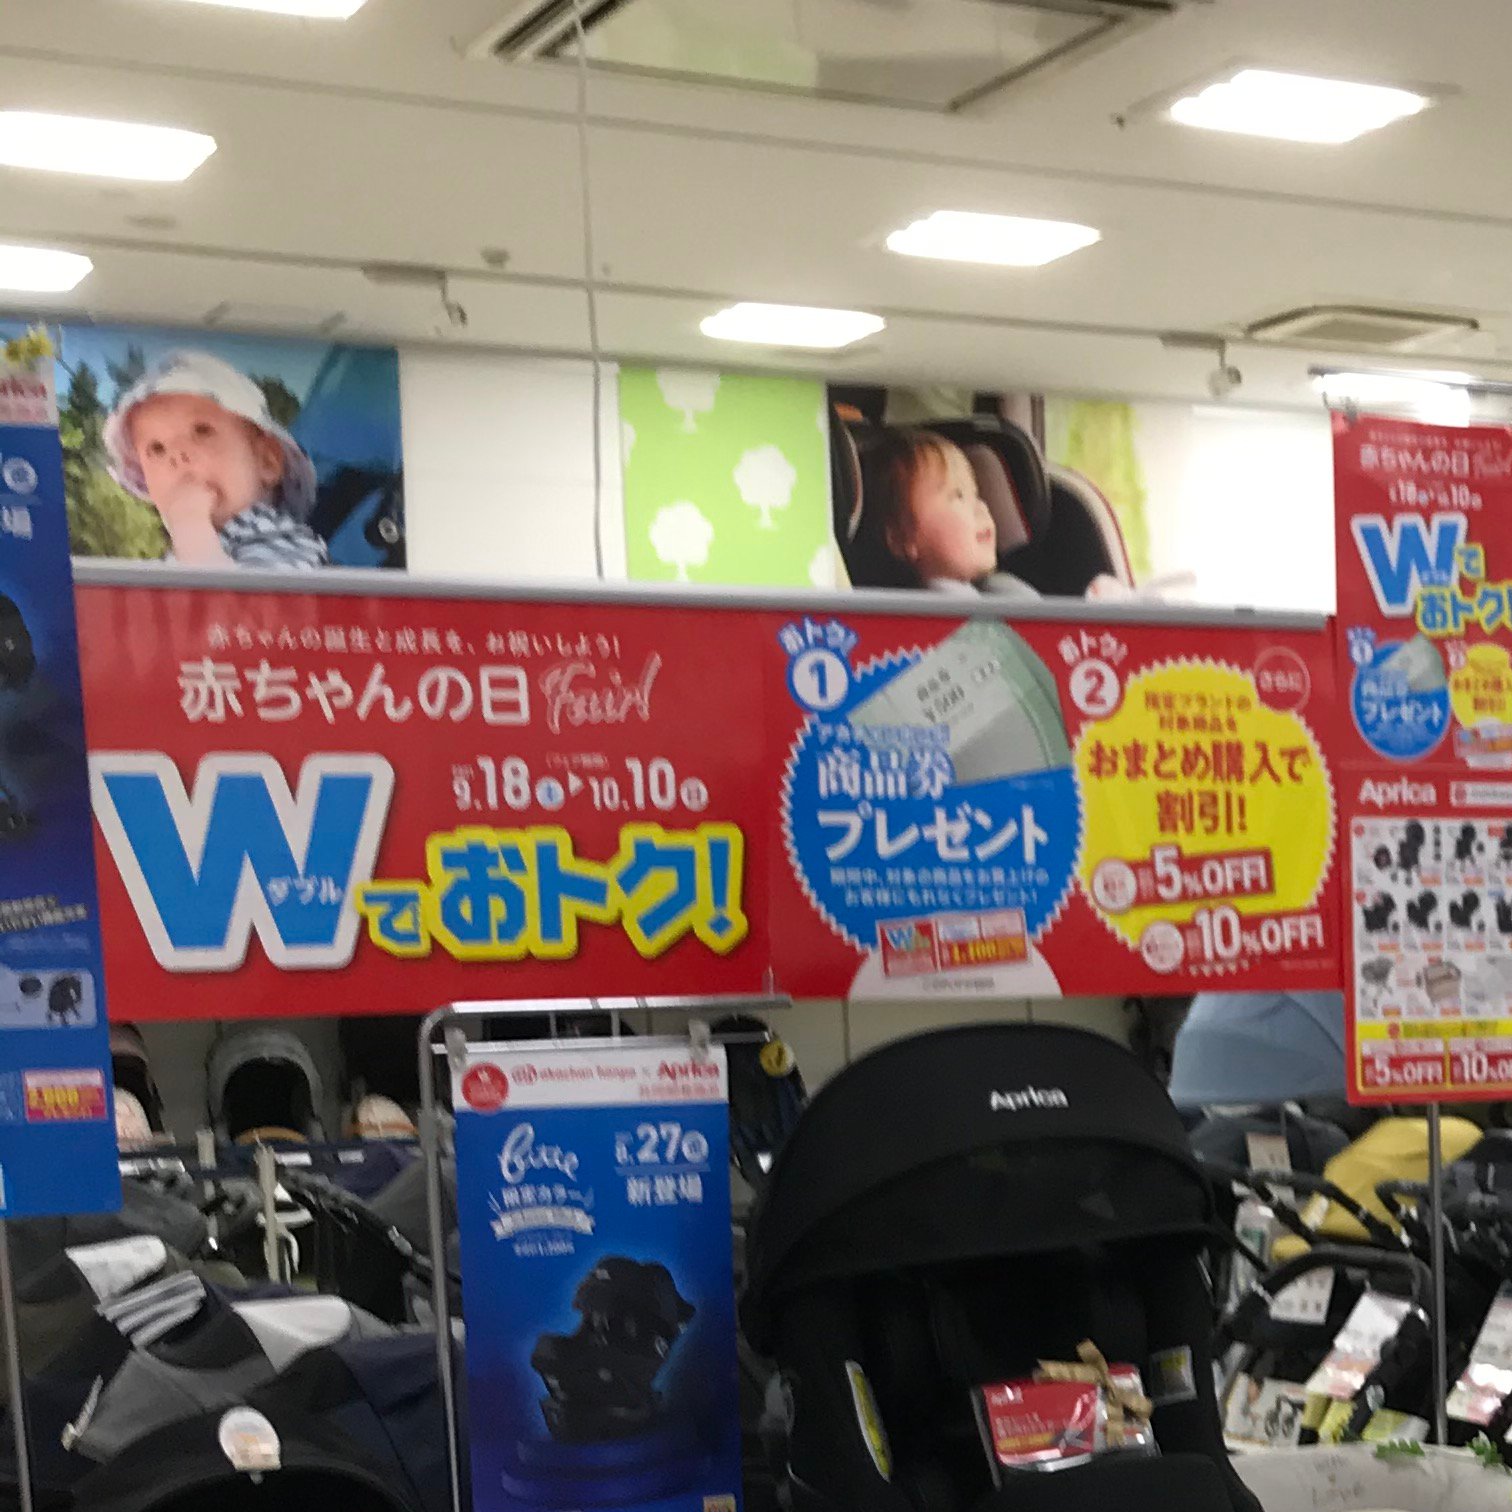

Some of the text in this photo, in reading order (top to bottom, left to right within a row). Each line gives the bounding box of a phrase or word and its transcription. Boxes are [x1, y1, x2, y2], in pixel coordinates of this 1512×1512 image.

[178, 657, 531, 726] 赤ちゃんの日
[1088, 740, 1310, 787] おまとめ購入で
[1359, 777, 1437, 809] Aprica
[817, 803, 1048, 865] プレゼント
[990, 1085, 1070, 1112] Aprica
